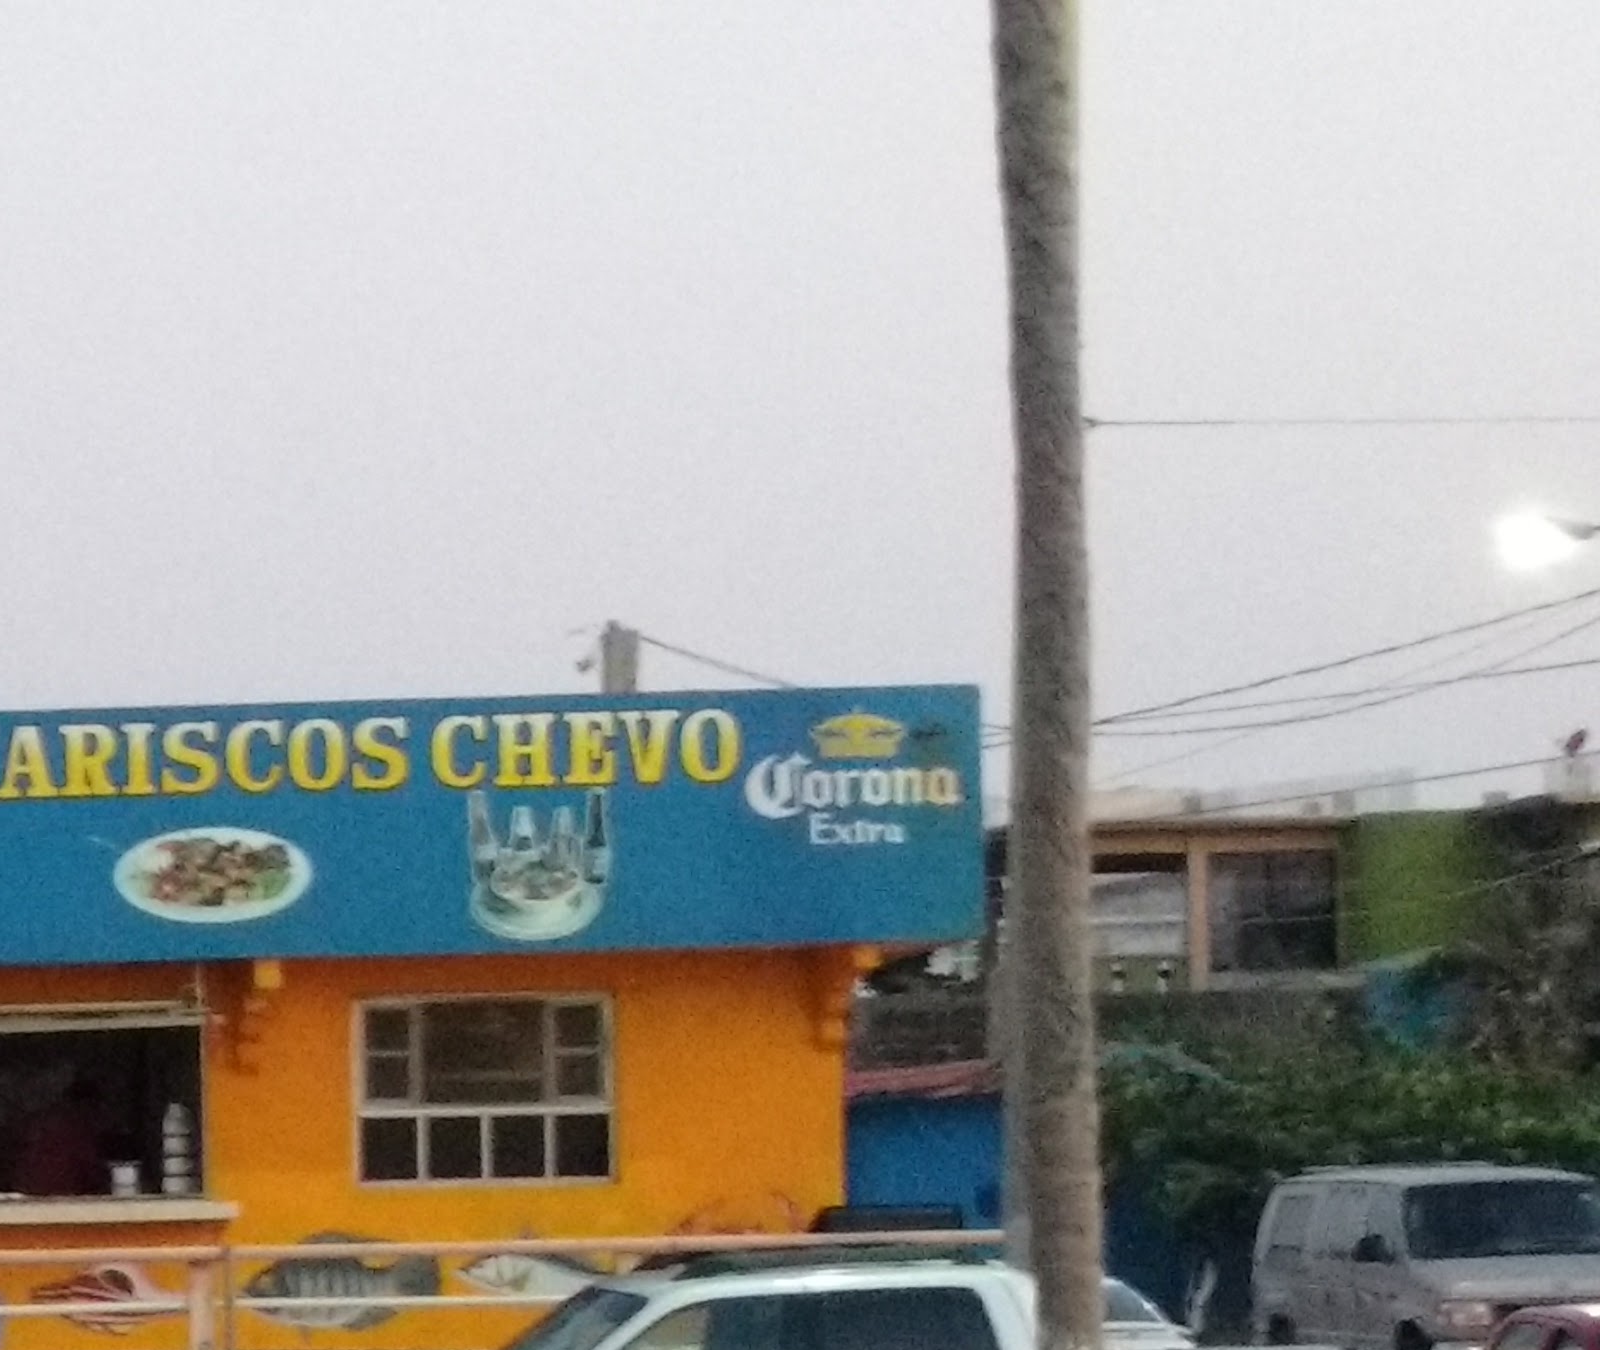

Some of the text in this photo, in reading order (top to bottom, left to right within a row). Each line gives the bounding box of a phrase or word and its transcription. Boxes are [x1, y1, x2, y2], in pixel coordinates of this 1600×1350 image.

[432, 708, 742, 791] CHEVO
[746, 752, 962, 819] Corona
[809, 812, 905, 845] Extra
